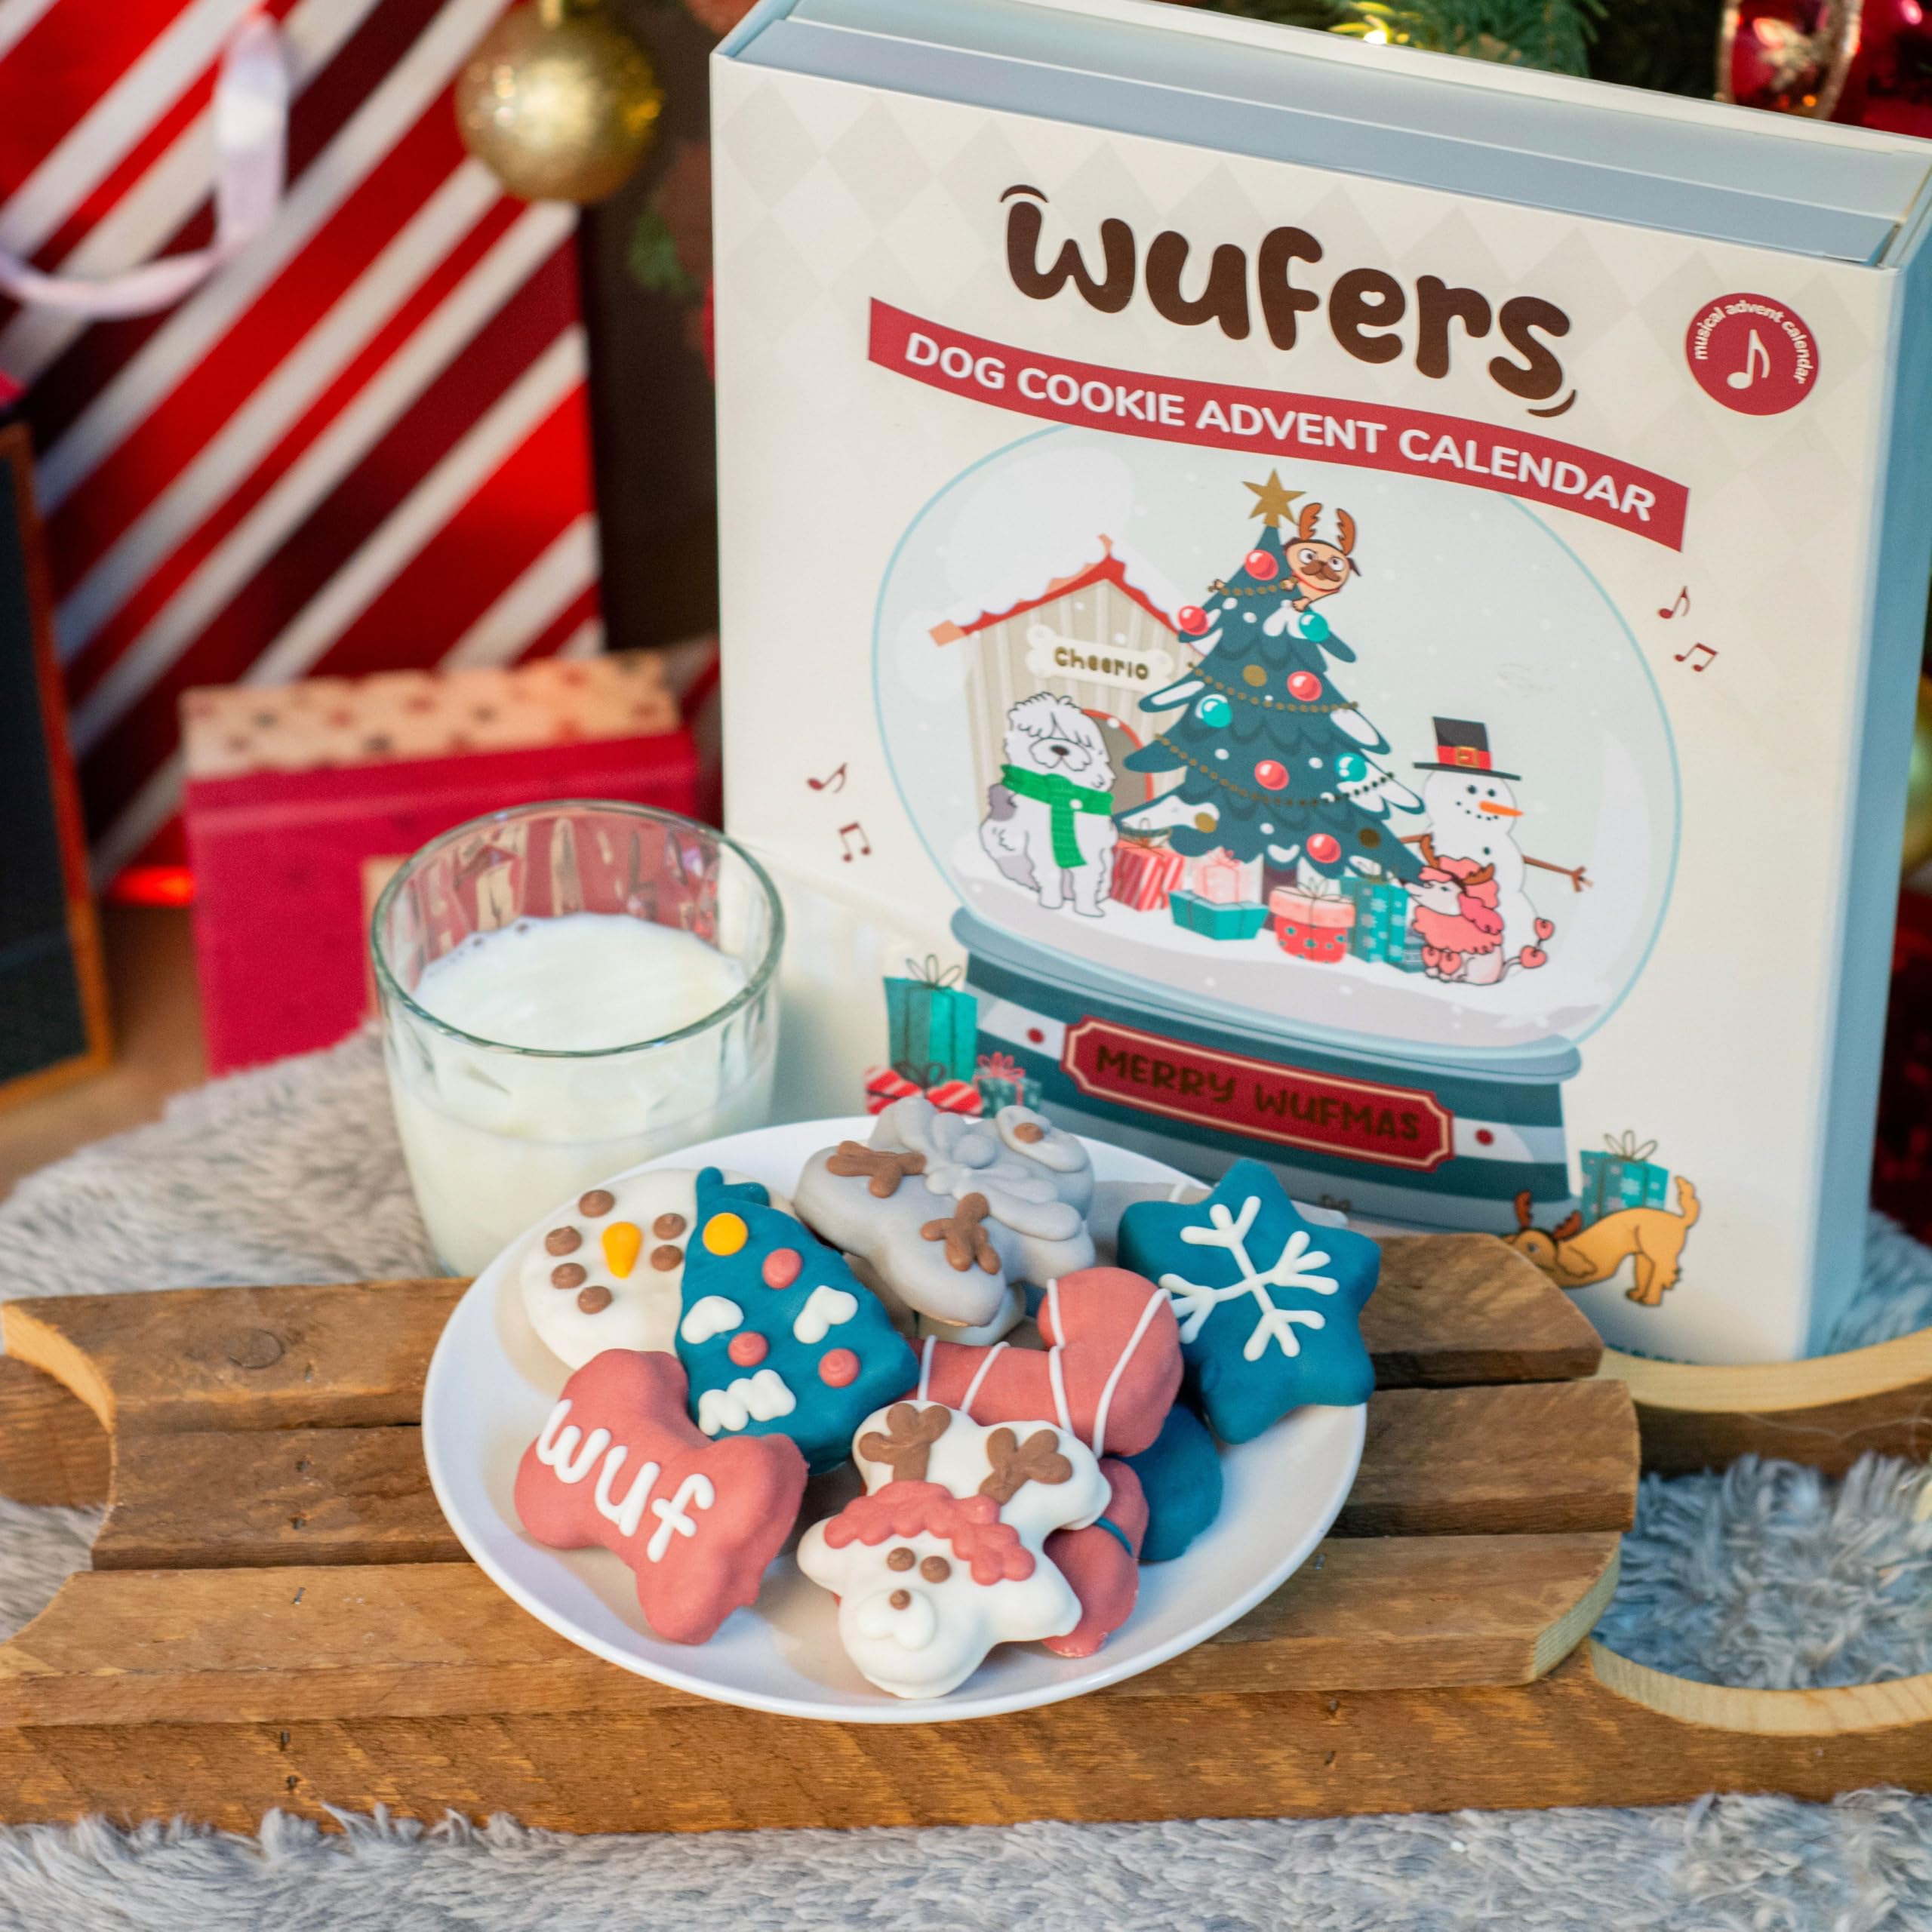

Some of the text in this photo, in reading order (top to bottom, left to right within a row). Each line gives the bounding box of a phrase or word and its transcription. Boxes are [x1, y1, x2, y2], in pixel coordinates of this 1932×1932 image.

[1007, 199, 1572, 401] wufers
[1694, 300, 1814, 384] musical advent calendar
[905, 331, 1657, 522] DOG COOKIE ADVENT CALENDAR
[1054, 646, 1149, 680] Cheerio
[1095, 1044, 1420, 1142] MERRY WUFMAS
[536, 1398, 715, 1564] wuf
